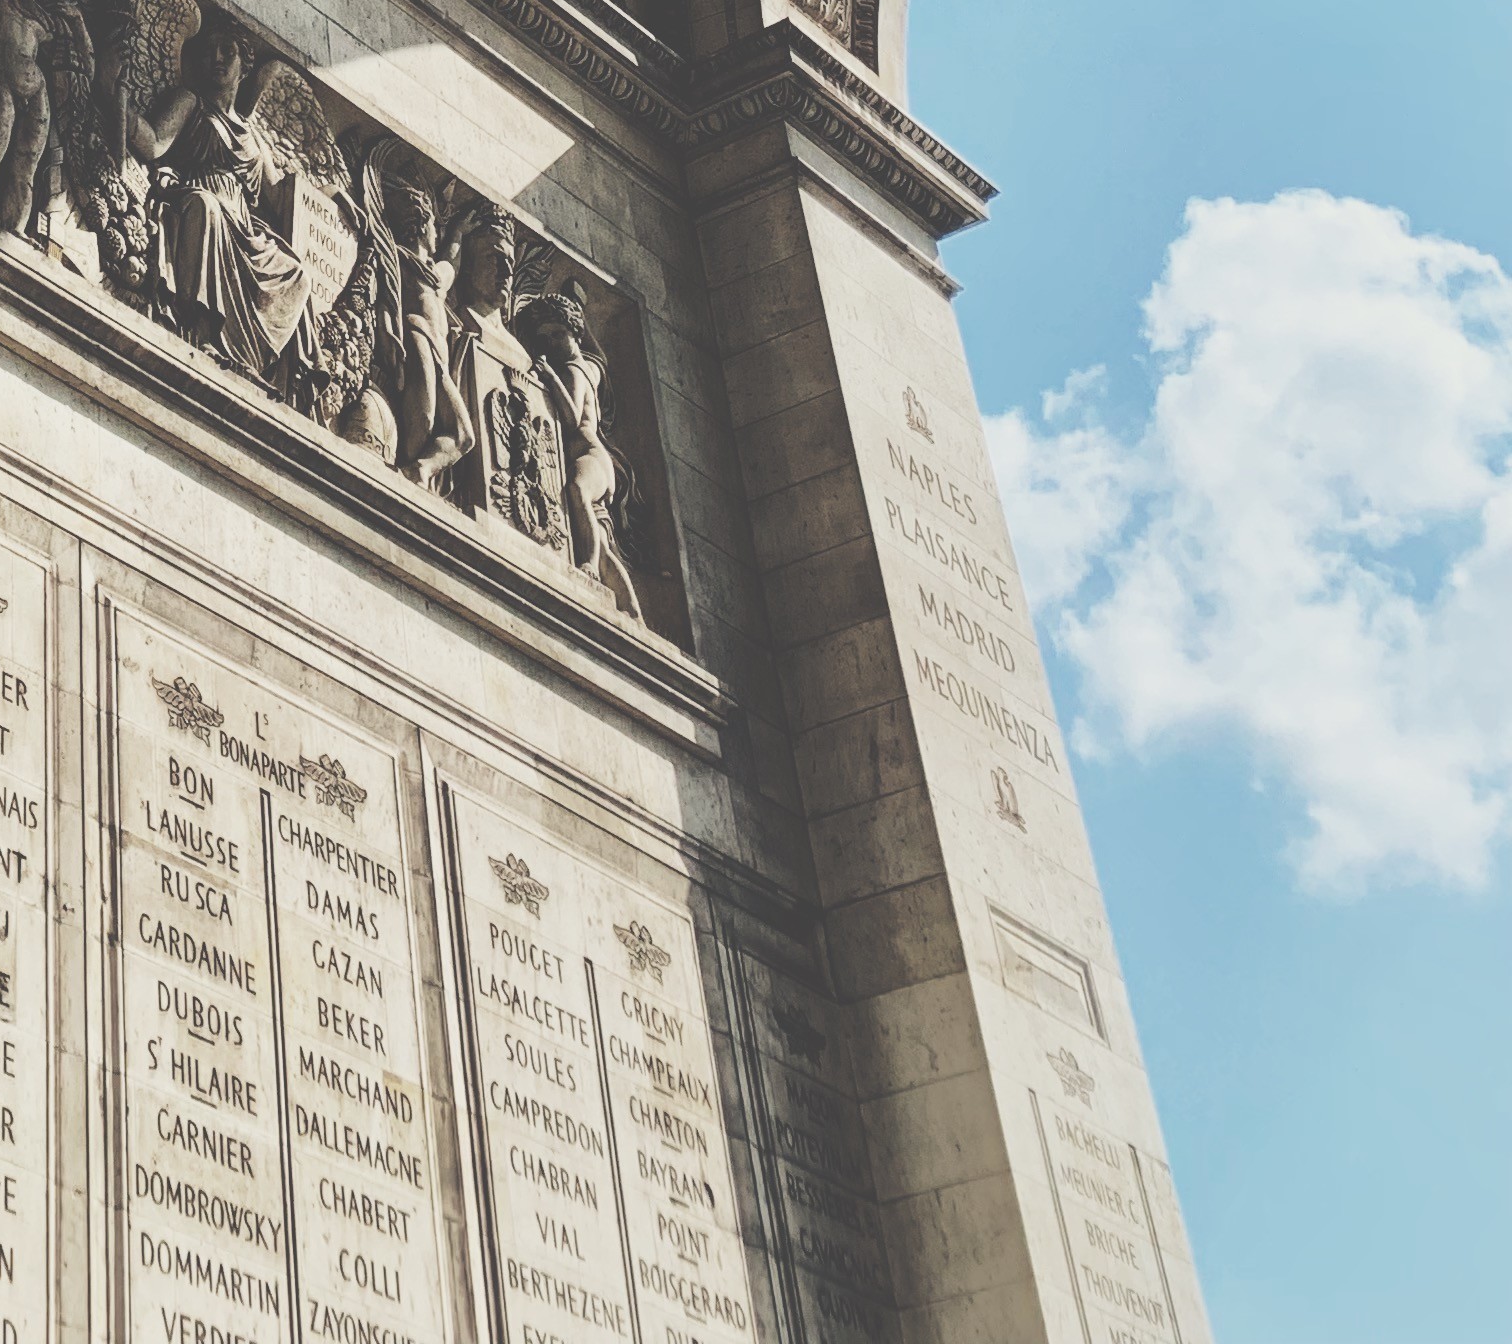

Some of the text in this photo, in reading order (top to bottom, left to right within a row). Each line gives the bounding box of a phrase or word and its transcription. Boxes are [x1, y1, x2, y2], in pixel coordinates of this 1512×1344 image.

[304, 248, 345, 289] ARCOLE
[309, 223, 343, 261] RIVOLI
[887, 437, 978, 526] NAPLES
[884, 495, 1014, 614] PLAISANCE
[918, 583, 1016, 675] MADRID
[912, 647, 1060, 774] MEQUINENZA
[168, 755, 214, 806] BON
[219, 730, 307, 800] BONAPARTE
[145, 800, 241, 874] LANUSSE
[277, 814, 401, 900] CHARPENTIER
[160, 863, 233, 927] RUSCA
[305, 879, 380, 942] DAMAS
[157, 980, 243, 1047] DUBOIS
[317, 997, 387, 1057] BEKER
[171, 1048, 259, 1118] HILAIRE
[299, 1045, 414, 1124] MARCHAND
[609, 1034, 714, 1111] CHAMPEAUX
[490, 1080, 606, 1161] CAMPREDON
[629, 1095, 709, 1158] CHARTON
[1054, 1114, 1121, 1170] BACHELU
[134, 1163, 283, 1254] DOMBROWSKY
[318, 1177, 411, 1244] CHABERT
[509, 1145, 599, 1212] CHABRAN
[535, 1212, 587, 1262] VIAL
[657, 1216, 711, 1262] POINT
[1084, 1218, 1141, 1271] BRICHE
[140, 1230, 281, 1319] DOMMARTIN
[339, 1247, 402, 1304] COLLI
